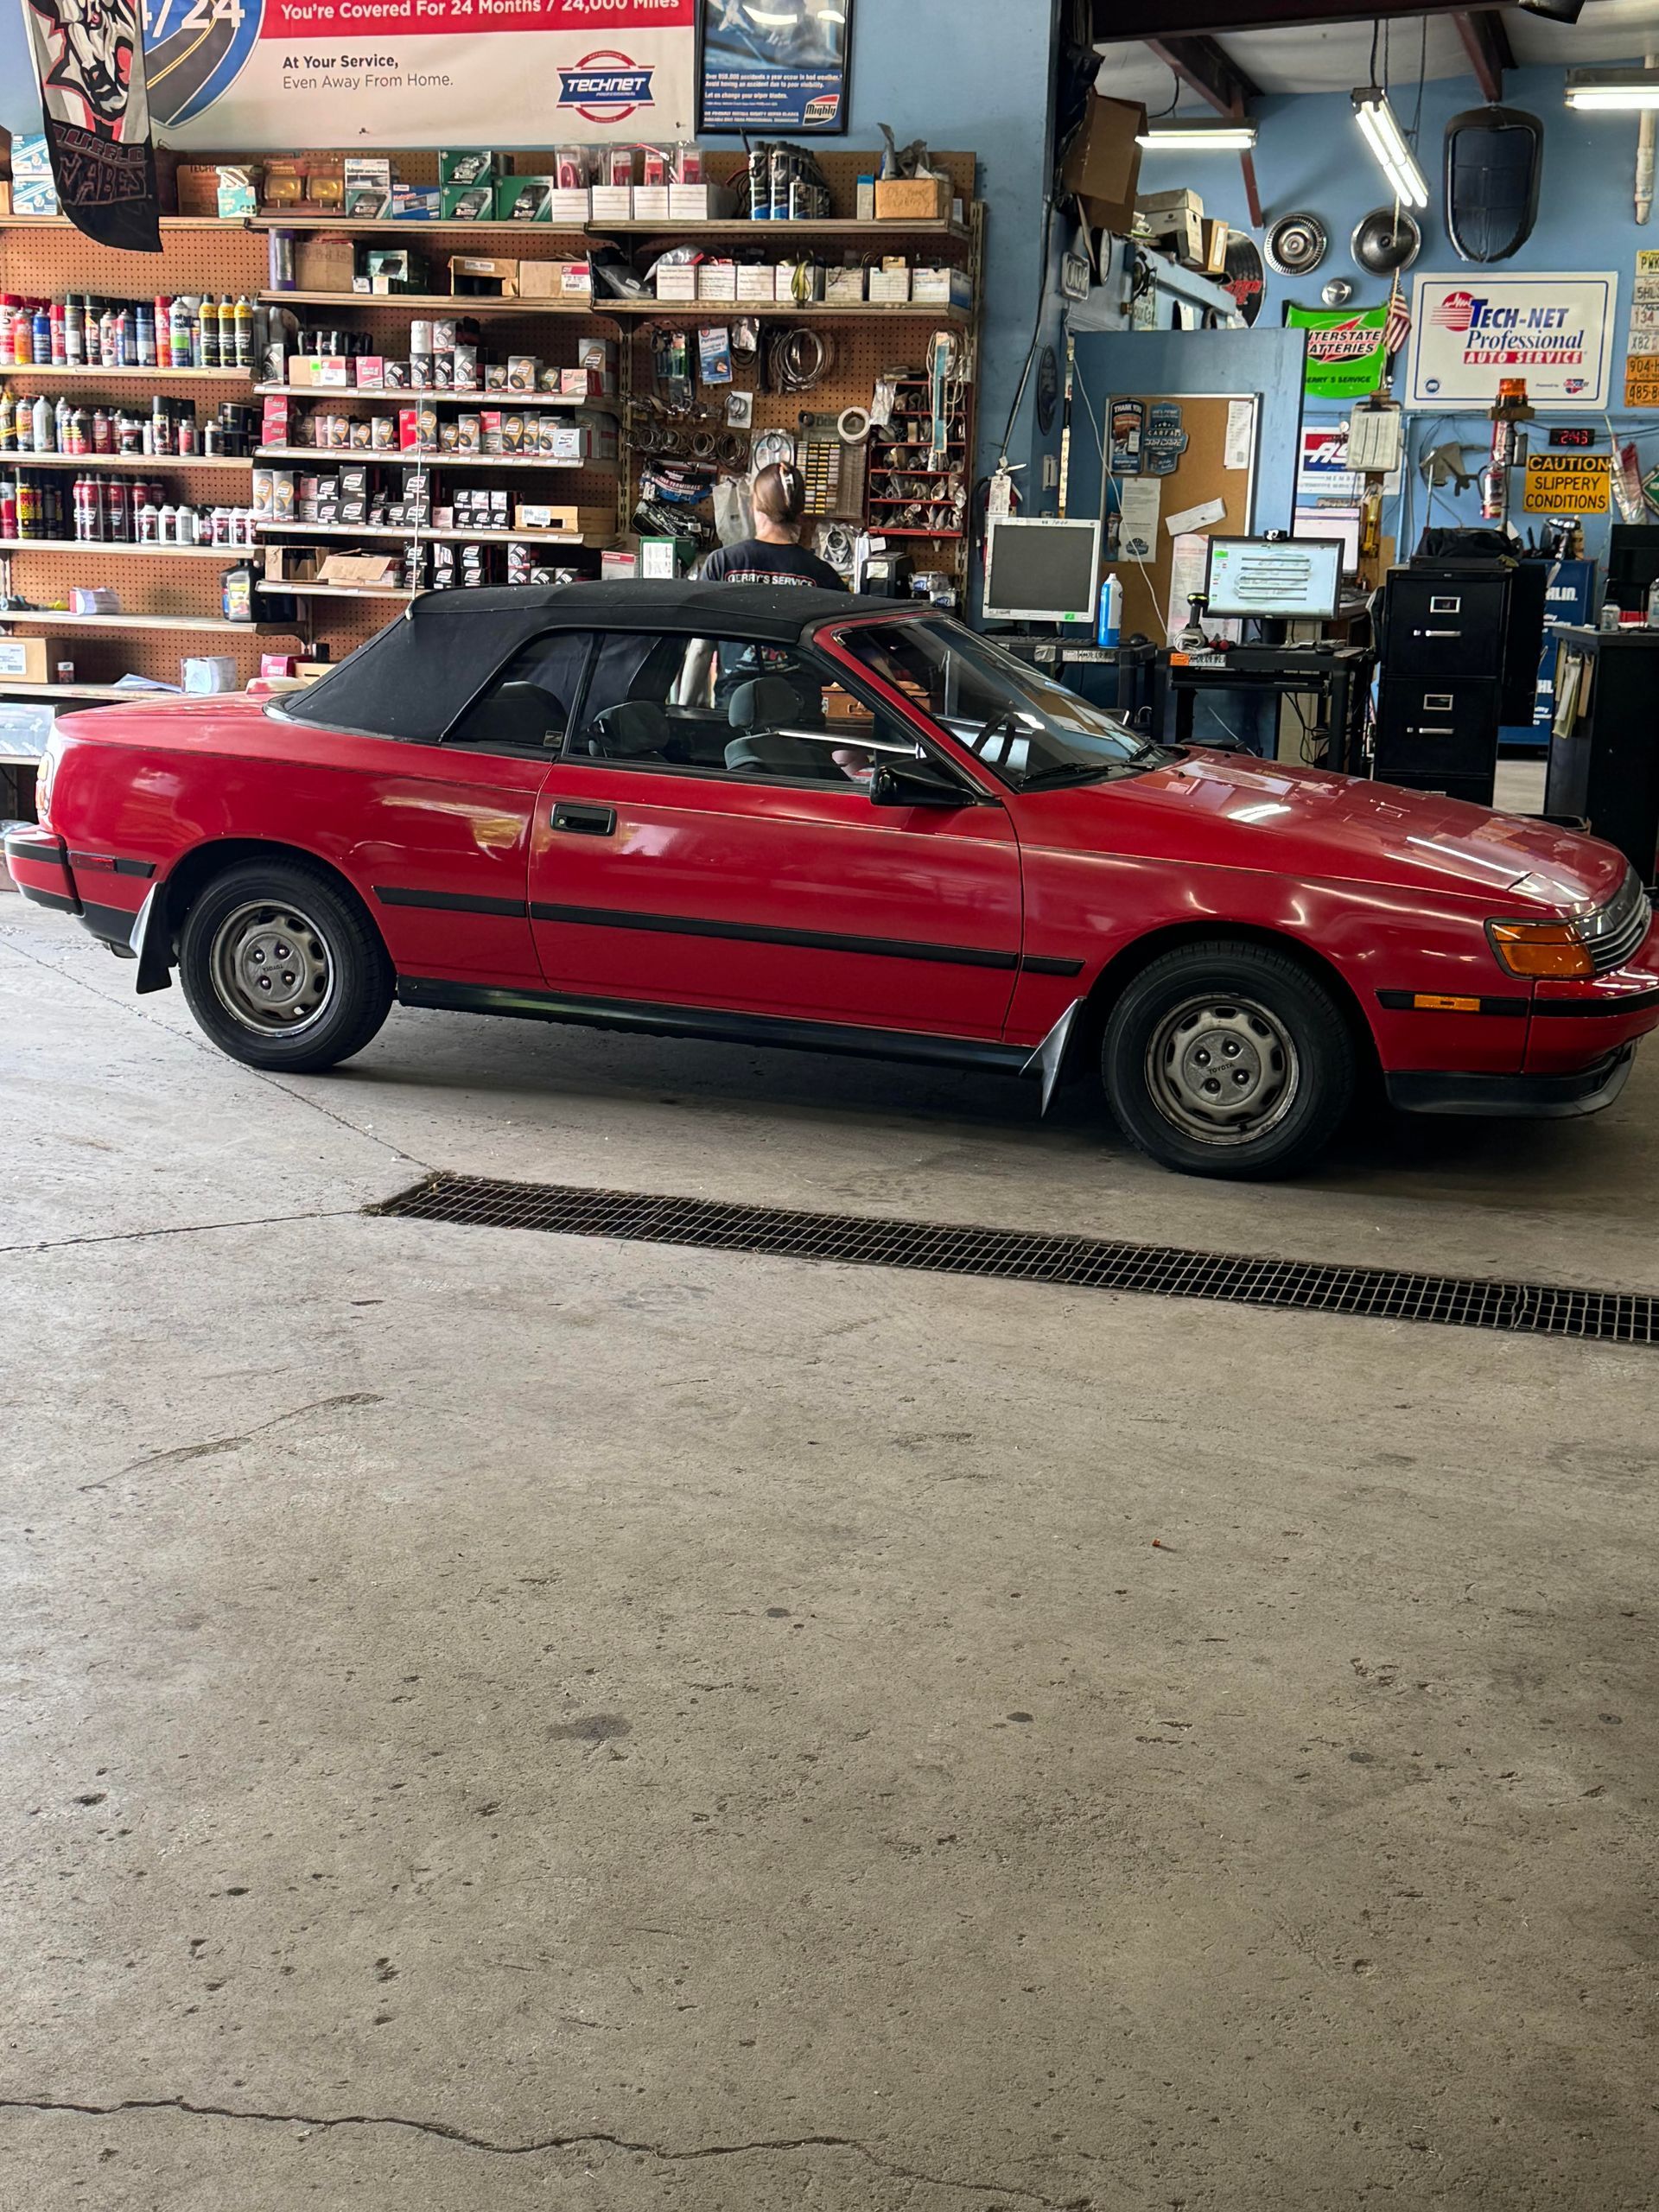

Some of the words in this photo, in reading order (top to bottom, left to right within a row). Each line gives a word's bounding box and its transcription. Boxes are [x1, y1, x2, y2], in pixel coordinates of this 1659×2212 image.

[281, 3, 334, 20] You're
[340, 1, 411, 18] Covered
[416, 1, 444, 16] For
[451, 0, 474, 15] 24
[479, 0, 542, 14] Months
[546, 0, 555, 12] /
[562, 0, 627, 15] 24,000
[283, 56, 299, 69] At
[303, 56, 337, 69] Your
[340, 54, 399, 69] Service,
[283, 75, 316, 89] Even
[321, 75, 361, 91] Away
[365, 73, 403, 87] From
[408, 73, 454, 86] Home.
[806, 104, 836, 116] Mighty
[1468, 298, 1569, 328] TECH-NET
[1307, 331, 1382, 341] TERSTATE
[1465, 329, 1585, 351] Professional
[1309, 343, 1375, 353] ATTERIES
[1466, 353, 1507, 363] AUTO
[1516, 352, 1580, 363] SERVICE
[1309, 442, 1348, 463] AS
[1529, 457, 1609, 471] CAUTION
[1535, 476, 1600, 491] SLIPPERY
[1525, 493, 1605, 509] CONDITIONS
[1208, 1062, 1235, 1075] TOYOTA
